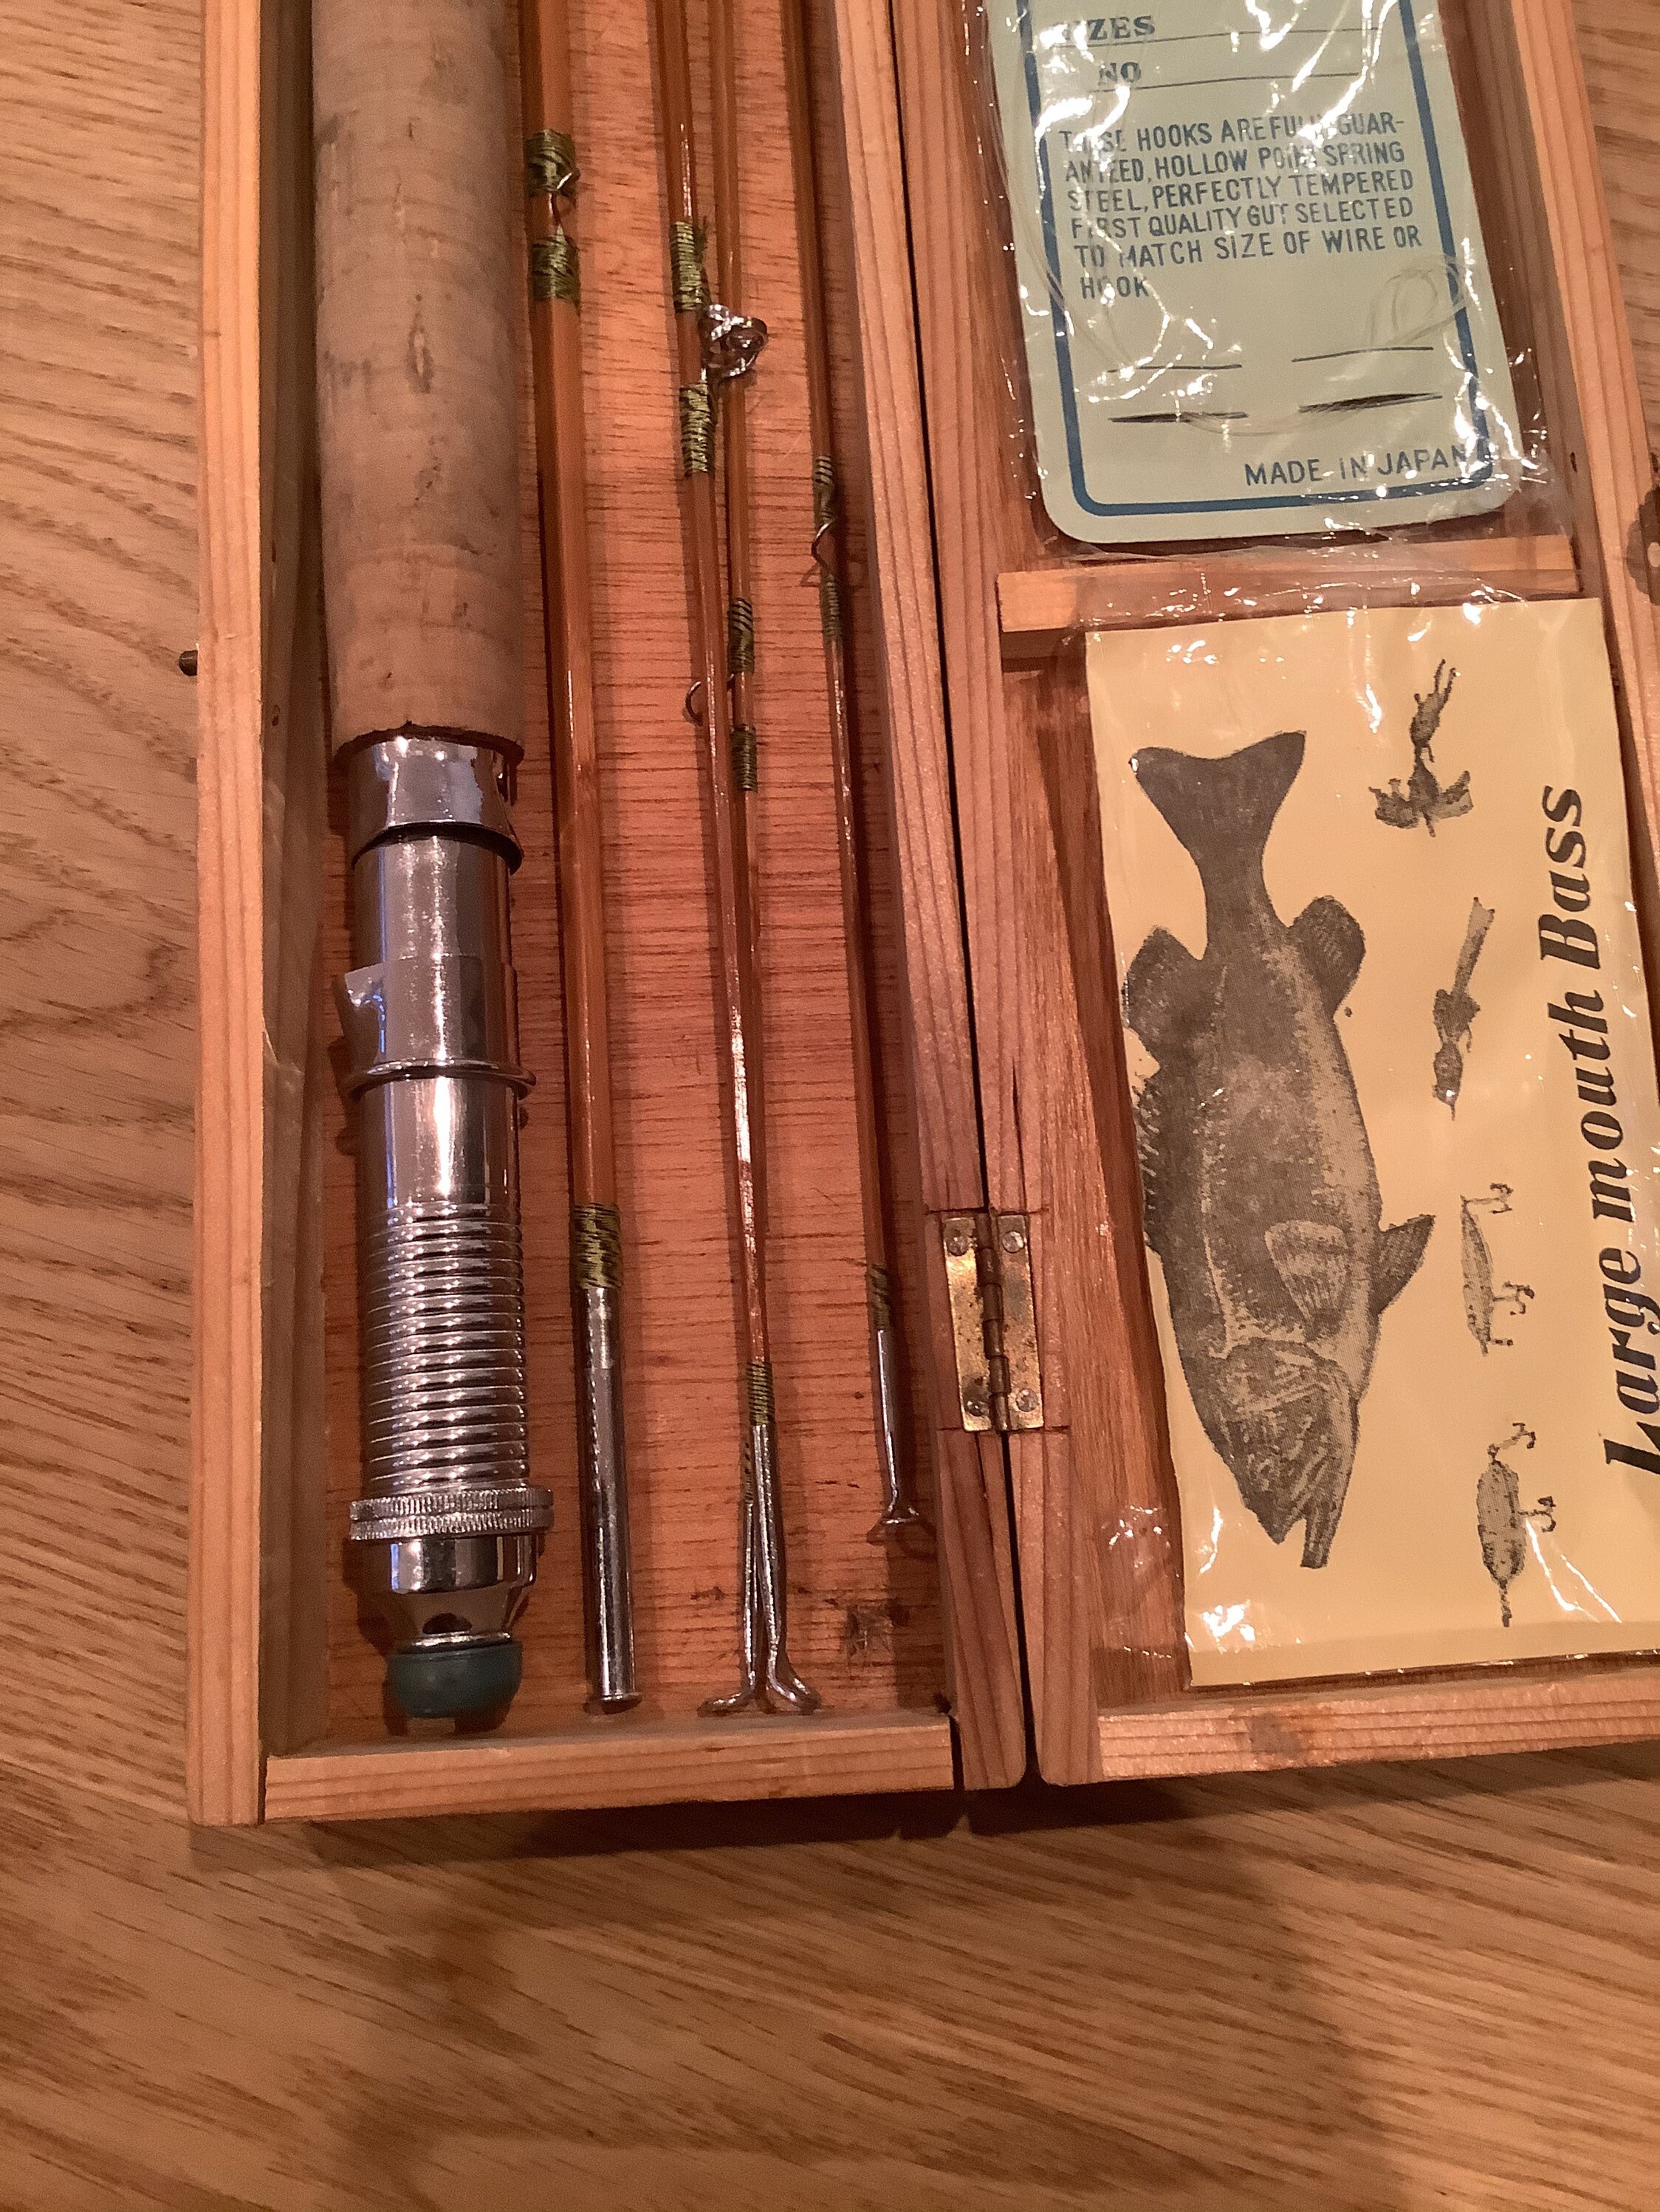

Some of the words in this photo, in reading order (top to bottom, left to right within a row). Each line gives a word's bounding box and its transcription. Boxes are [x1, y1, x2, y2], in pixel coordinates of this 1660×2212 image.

[1052, 15, 1156, 43] ZES
[1097, 61, 1142, 86] NO
[1058, 128, 1128, 154] TSE
[1137, 122, 1213, 152] HOOKS
[1221, 116, 1266, 144] ARE
[1337, 111, 1405, 137] GUAR-
[1154, 148, 1248, 180] HOLLOW
[1323, 140, 1405, 167] SPRING
[1152, 174, 1282, 210] PERFECTLY
[1288, 168, 1414, 197] TEMPERED
[1148, 205, 1242, 237] QUALITY
[1246, 202, 1289, 227] GUT
[1294, 196, 1413, 224] SELECTED
[1074, 244, 1105, 268] TO
[1119, 238, 1203, 268] MATCH
[1213, 231, 1275, 259] SIZE
[1283, 230, 1311, 255] OF
[1320, 226, 1386, 254] WIRE
[1393, 224, 1422, 249] OR
[1244, 458, 1324, 487] MADE
[1338, 454, 1368, 480] IN
[1537, 785, 1602, 969] Bass
[1547, 989, 1635, 1223] mouth
[1599, 1246, 1660, 1476] Large
